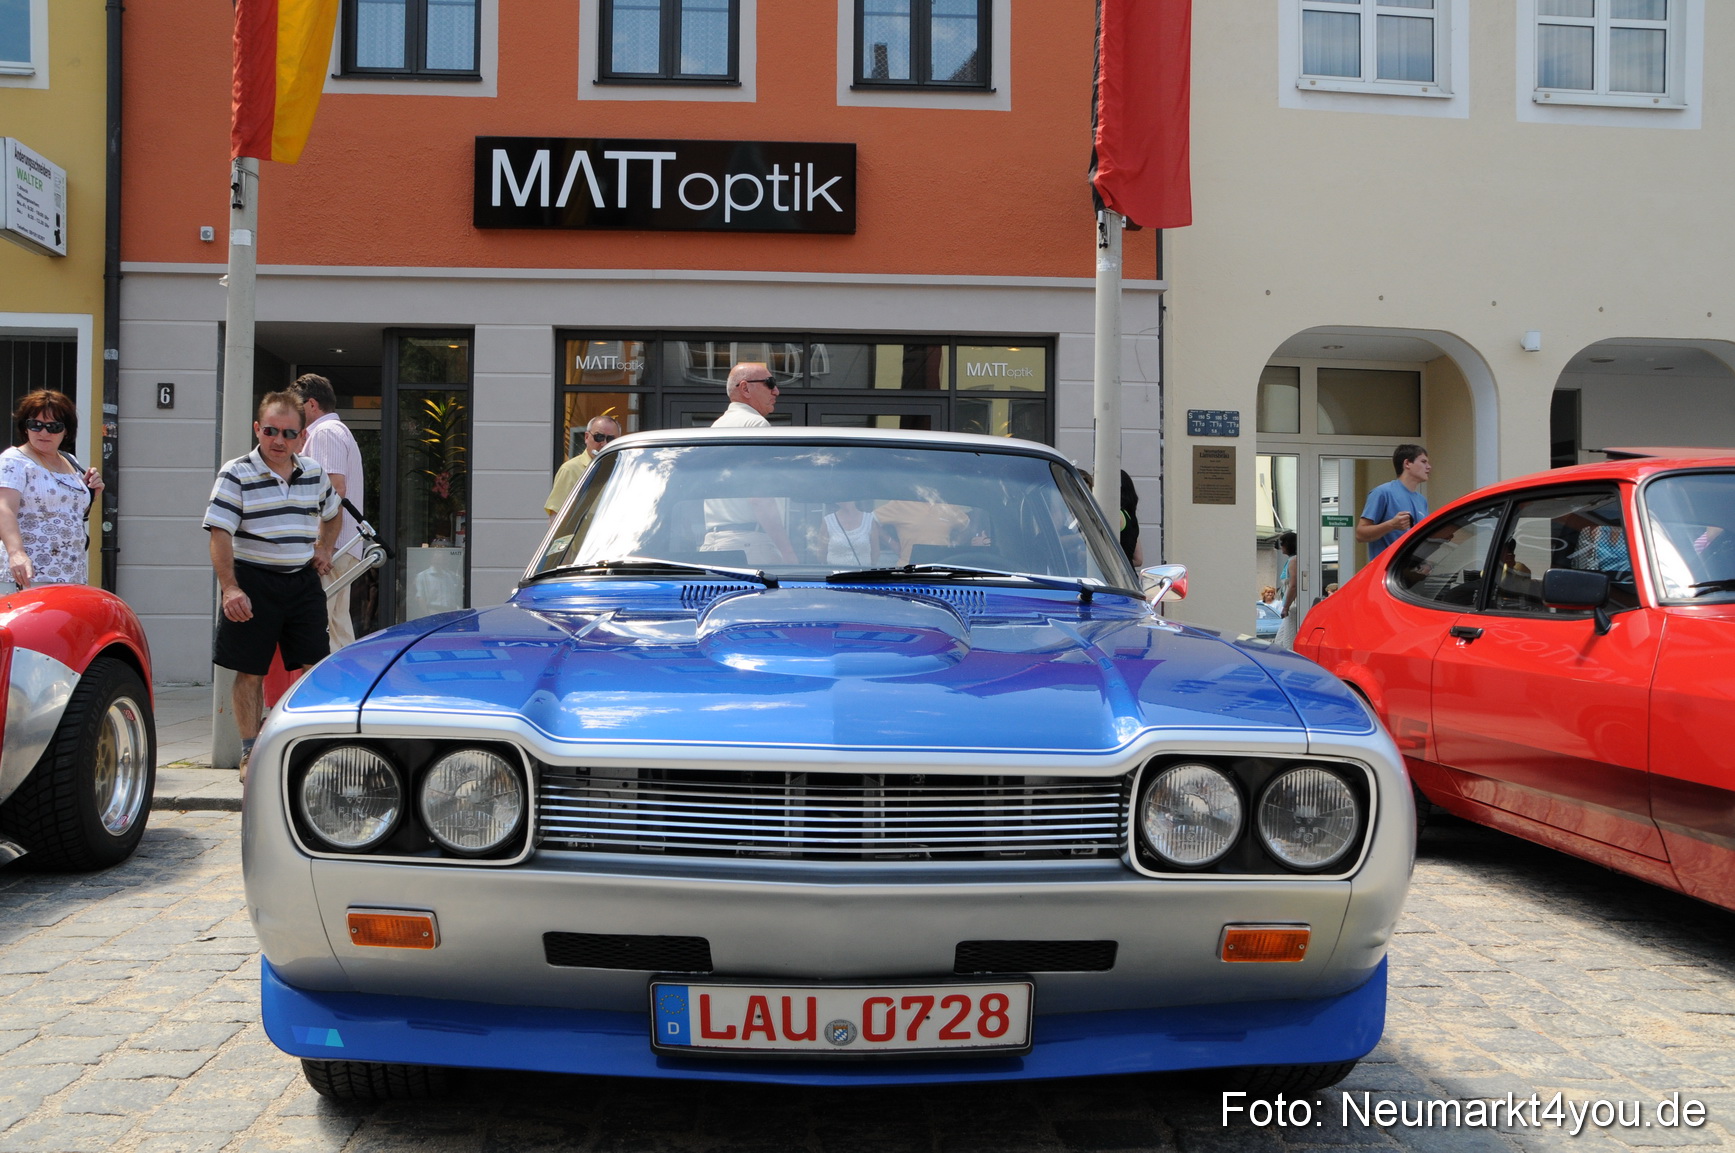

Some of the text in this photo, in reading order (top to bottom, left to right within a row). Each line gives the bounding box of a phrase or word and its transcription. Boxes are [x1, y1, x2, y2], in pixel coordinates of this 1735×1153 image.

[16, 166, 43, 192] WALTER
[160, 387, 171, 404] 6
[700, 994, 817, 1041] LAU
[863, 993, 1010, 1041] 0728
[668, 1022, 680, 1035] D
